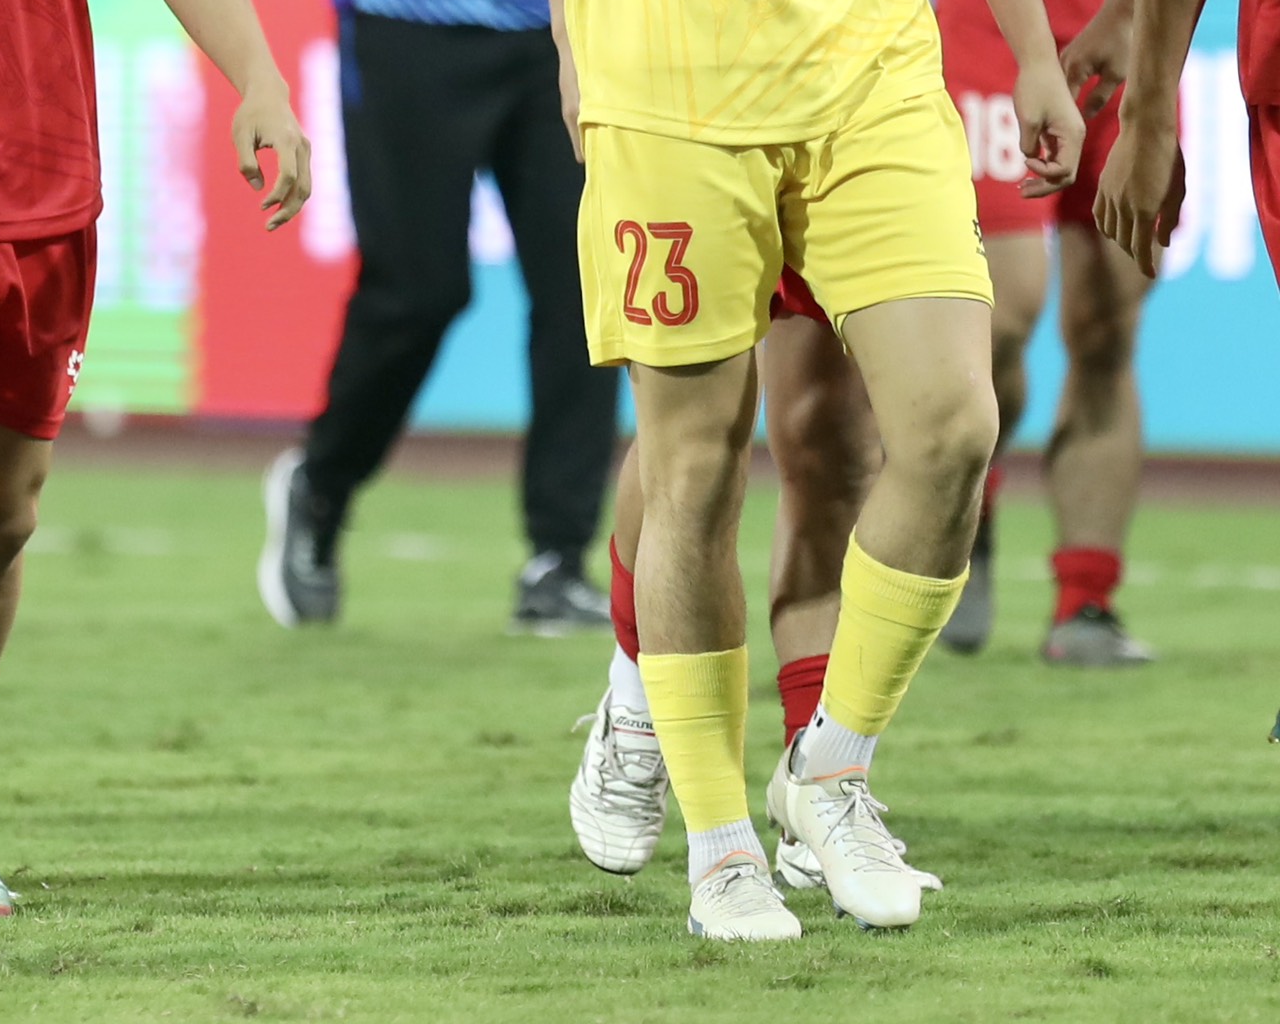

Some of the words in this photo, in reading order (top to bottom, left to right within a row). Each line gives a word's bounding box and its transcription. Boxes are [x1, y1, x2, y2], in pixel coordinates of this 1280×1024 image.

[960, 91, 1027, 182] 18
[615, 219, 699, 326] 23
[615, 716, 654, 730] MIZUN
